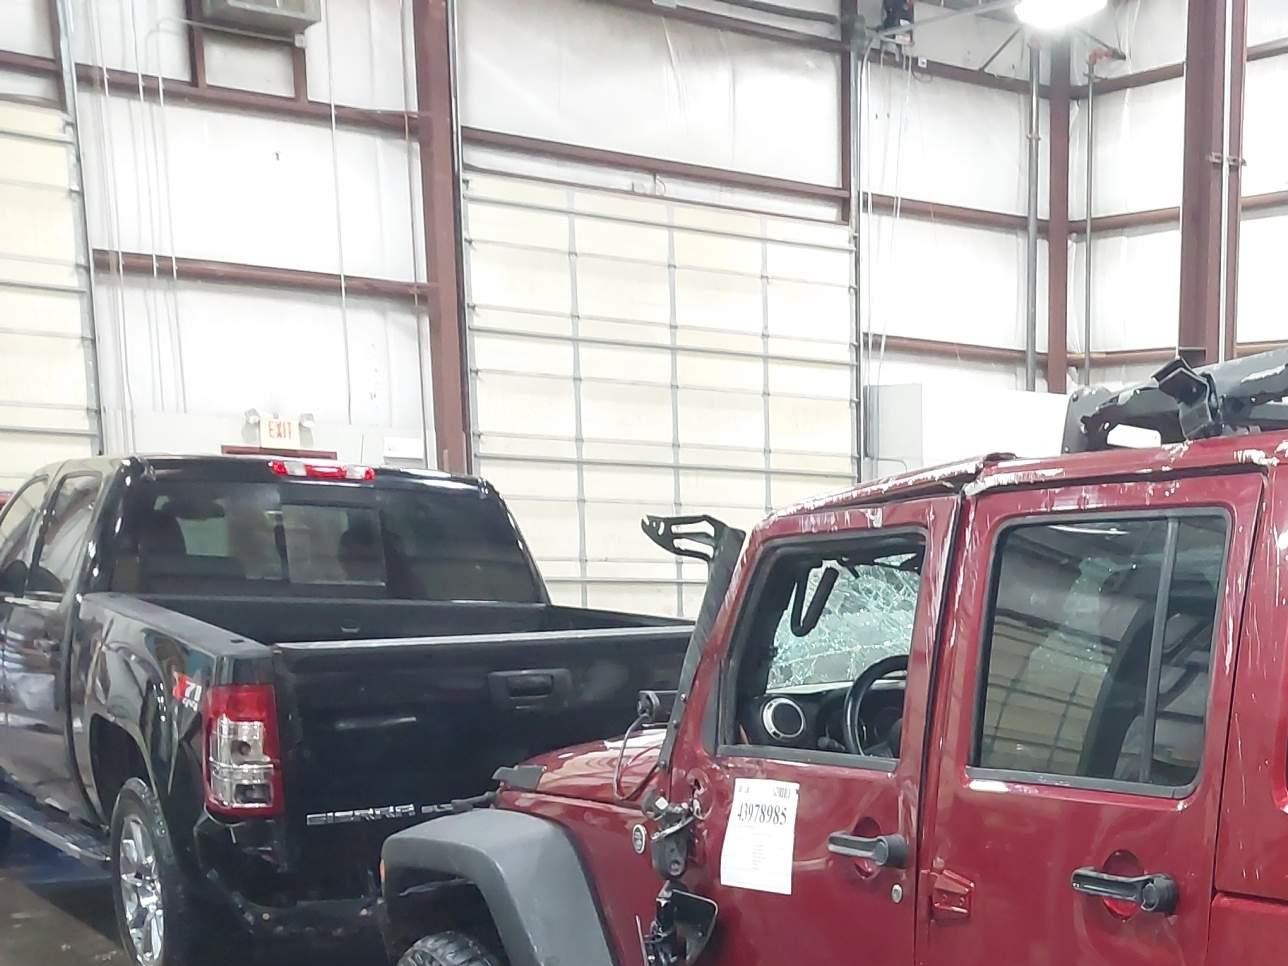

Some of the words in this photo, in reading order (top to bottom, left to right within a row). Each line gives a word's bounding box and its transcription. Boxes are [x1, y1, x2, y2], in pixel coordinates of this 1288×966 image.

[268, 420, 292, 440] EXIT
[306, 804, 415, 826] SIERRA
[737, 801, 788, 826] 43978985
